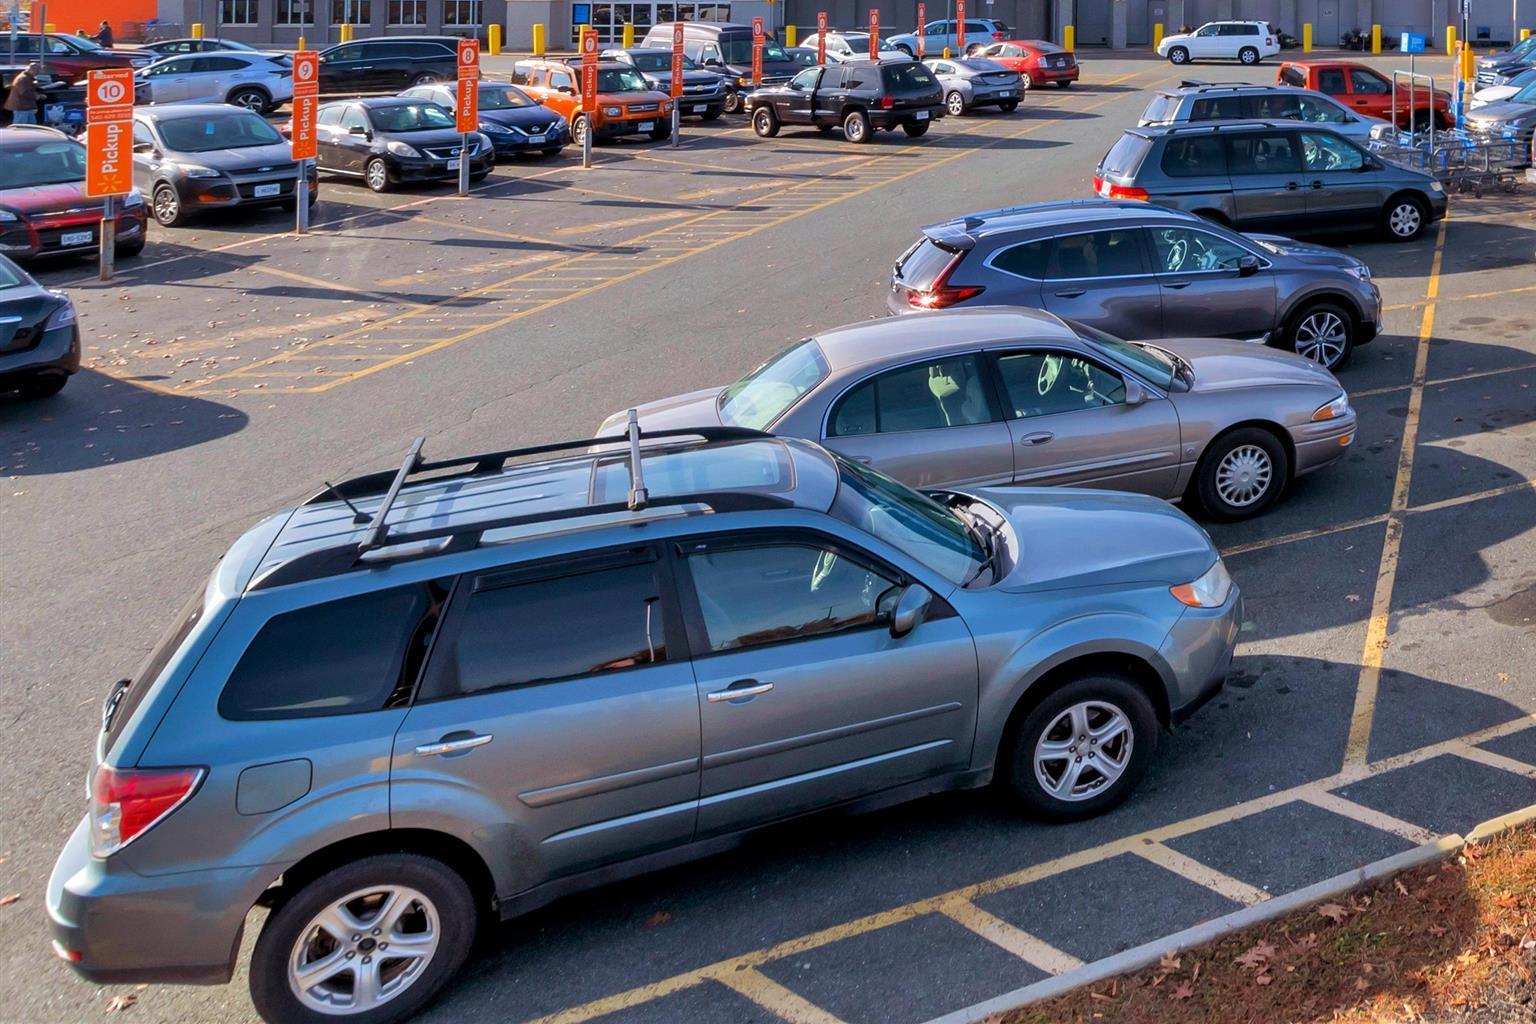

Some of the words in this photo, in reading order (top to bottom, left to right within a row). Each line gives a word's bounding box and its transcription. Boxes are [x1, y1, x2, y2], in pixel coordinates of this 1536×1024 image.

[101, 85, 121, 98] 10
[463, 80, 474, 116] Pickup
[300, 98, 312, 141] Pickup
[101, 124, 123, 174] Pickup
